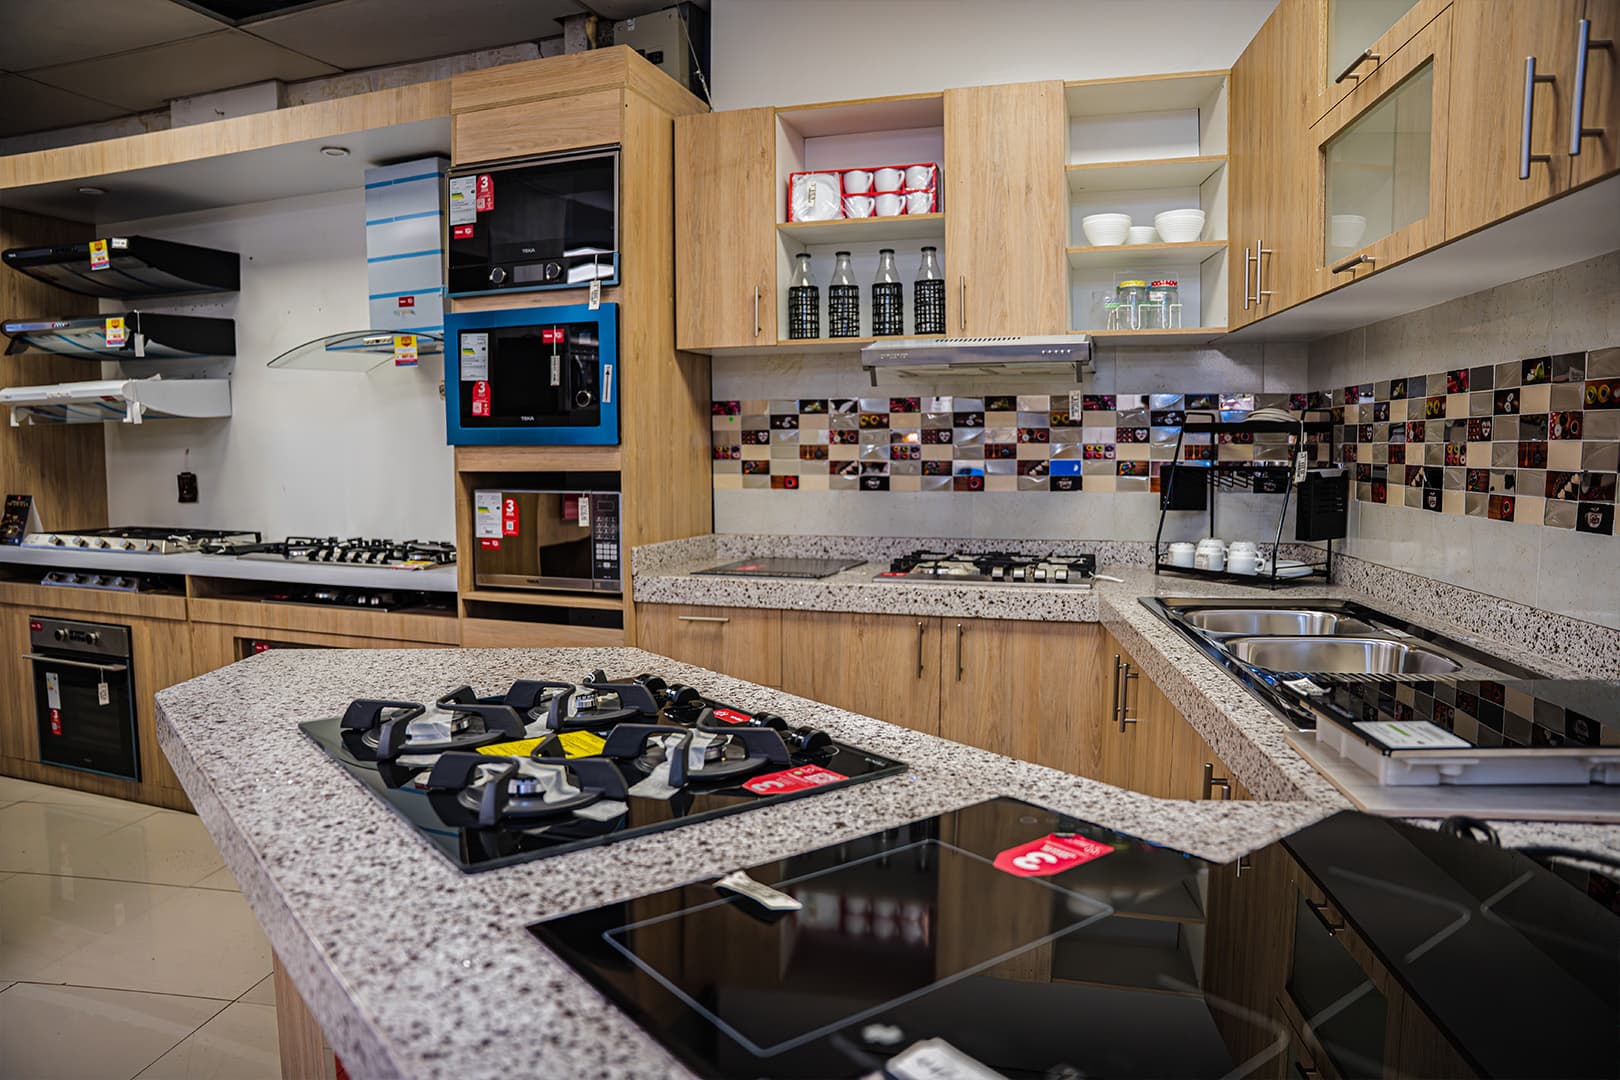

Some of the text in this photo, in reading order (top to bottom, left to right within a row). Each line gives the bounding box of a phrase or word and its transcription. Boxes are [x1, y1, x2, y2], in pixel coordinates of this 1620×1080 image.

[480, 176, 489, 188] 3
[478, 381, 486, 393] 3
[505, 499, 514, 512] 3
[1013, 851, 1057, 870] 3
